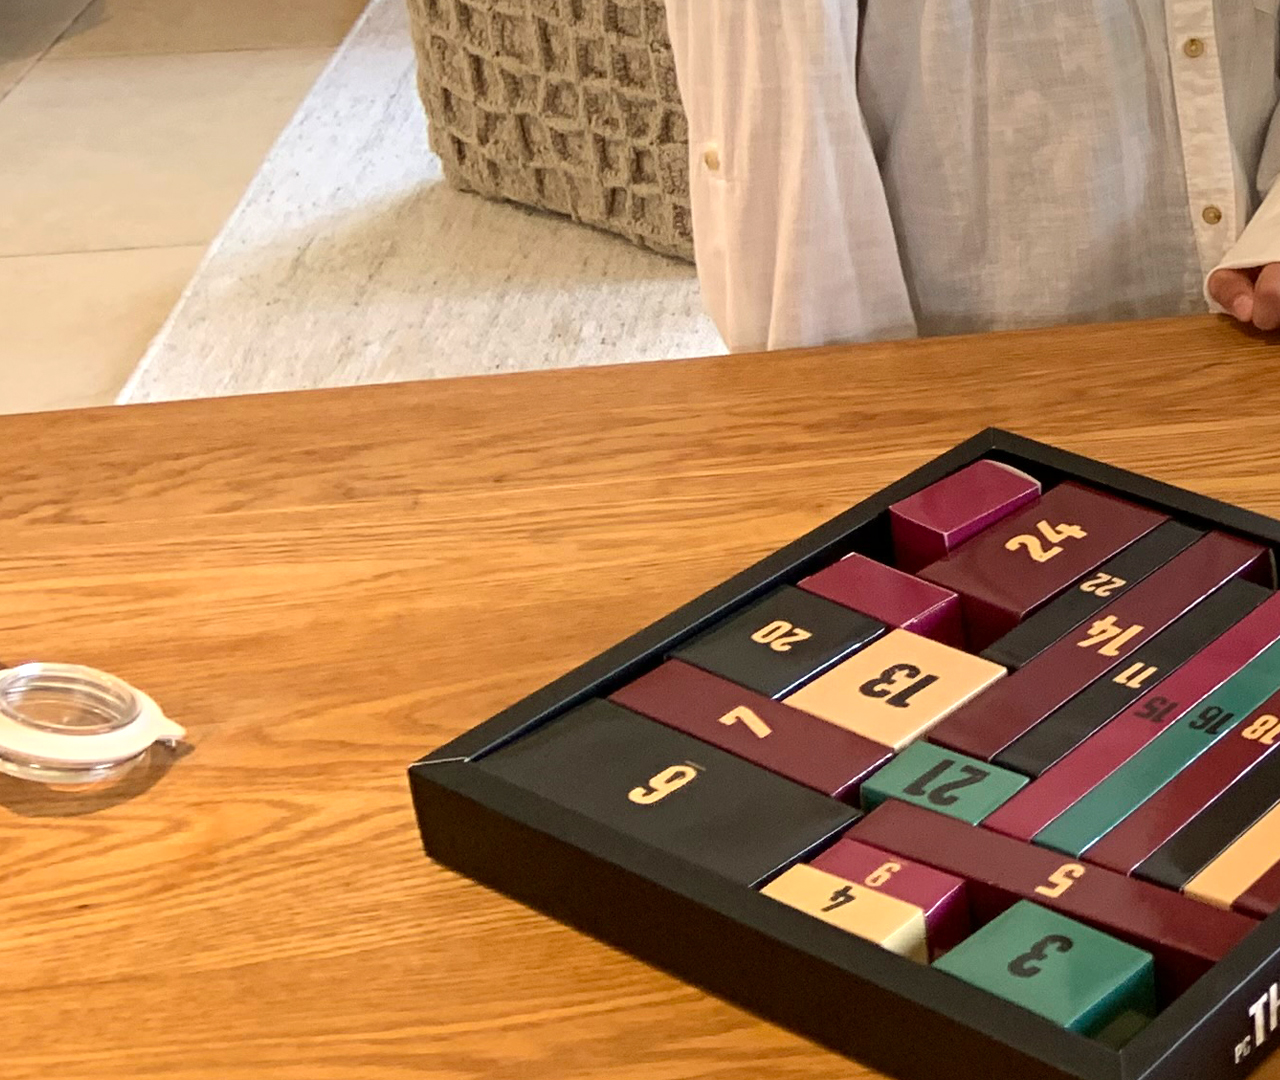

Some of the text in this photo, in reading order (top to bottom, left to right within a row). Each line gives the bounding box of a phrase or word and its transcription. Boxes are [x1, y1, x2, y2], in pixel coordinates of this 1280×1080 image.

[1006, 517, 1088, 563] 24
[1080, 573, 1126, 598] 22
[750, 619, 814, 653] 20
[1077, 616, 1145, 656] 14
[859, 663, 939, 709] 13
[1112, 663, 1158, 688] 11
[718, 706, 773, 739] 7
[1135, 696, 1179, 723] 15
[1188, 706, 1239, 734] 16
[903, 759, 985, 807] 21
[1035, 864, 1086, 897] 5
[821, 886, 856, 911] 4
[1007, 933, 1074, 978] 3
